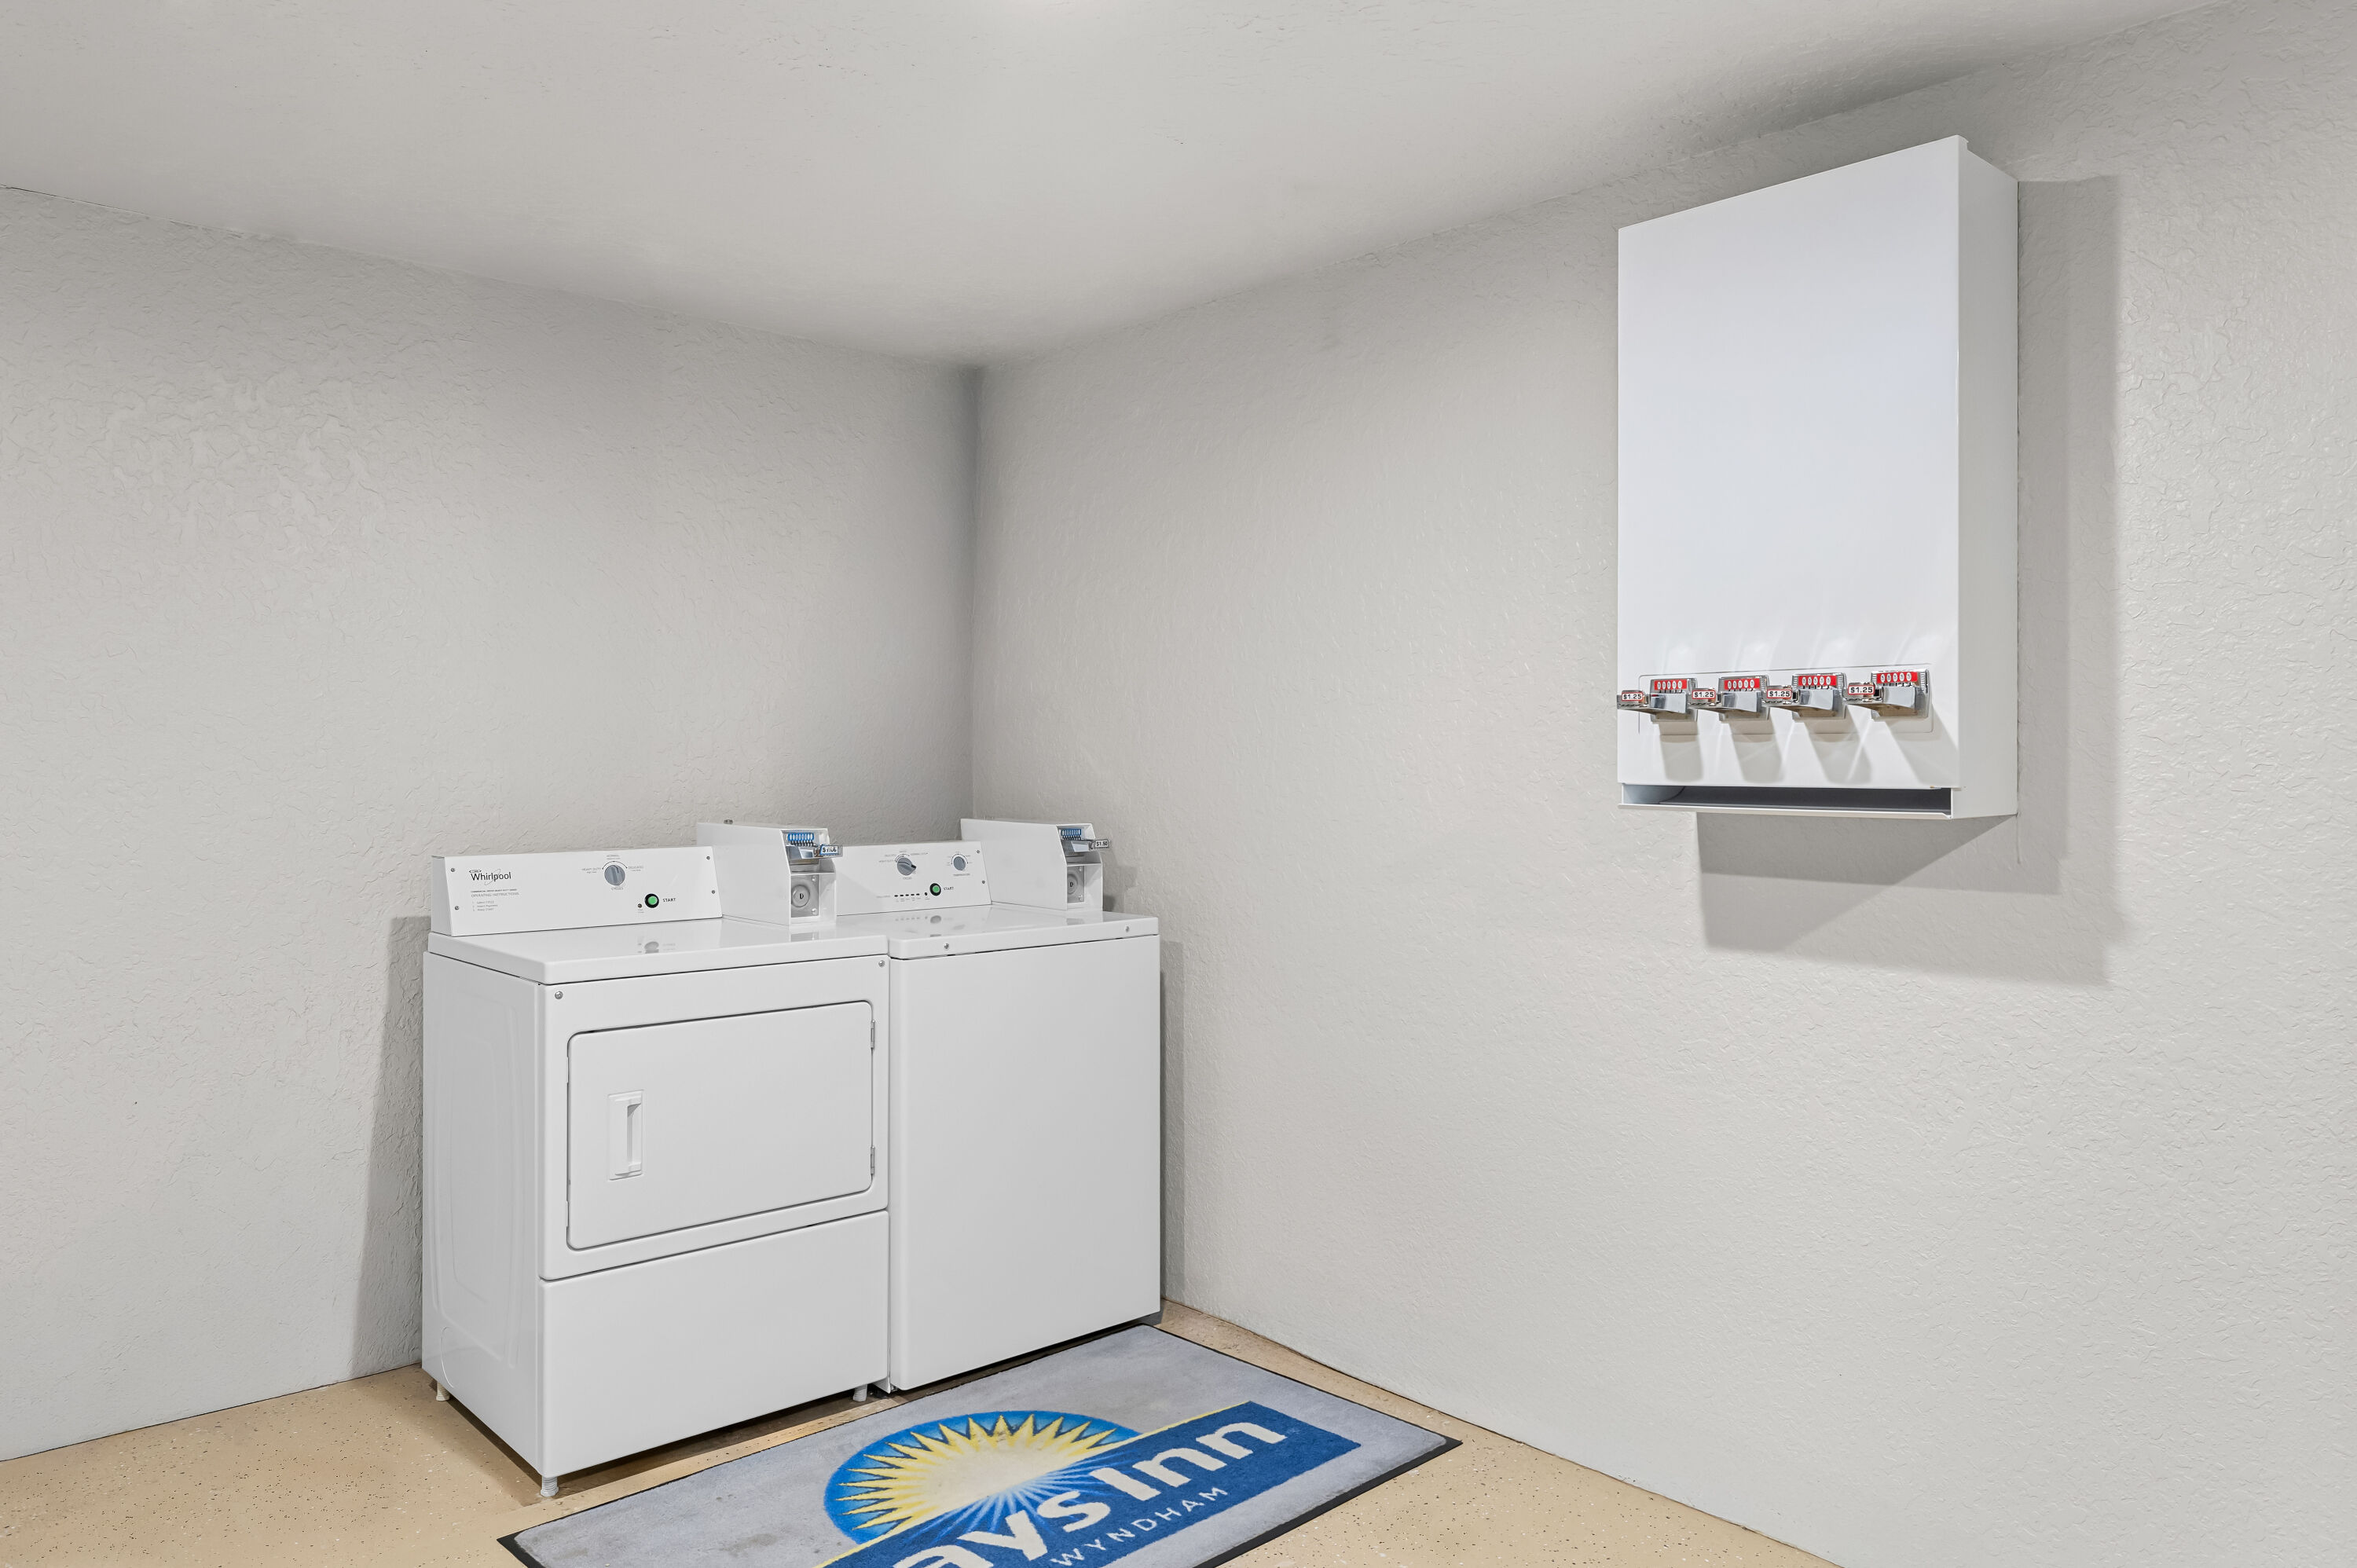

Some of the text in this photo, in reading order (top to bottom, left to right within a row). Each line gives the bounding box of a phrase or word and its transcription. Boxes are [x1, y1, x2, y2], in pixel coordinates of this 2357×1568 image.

[471, 871, 511, 882] Whirlpool
[1089, 1422, 1288, 1501] Inn
[1050, 1487, 1228, 1567] WYNDHAM
